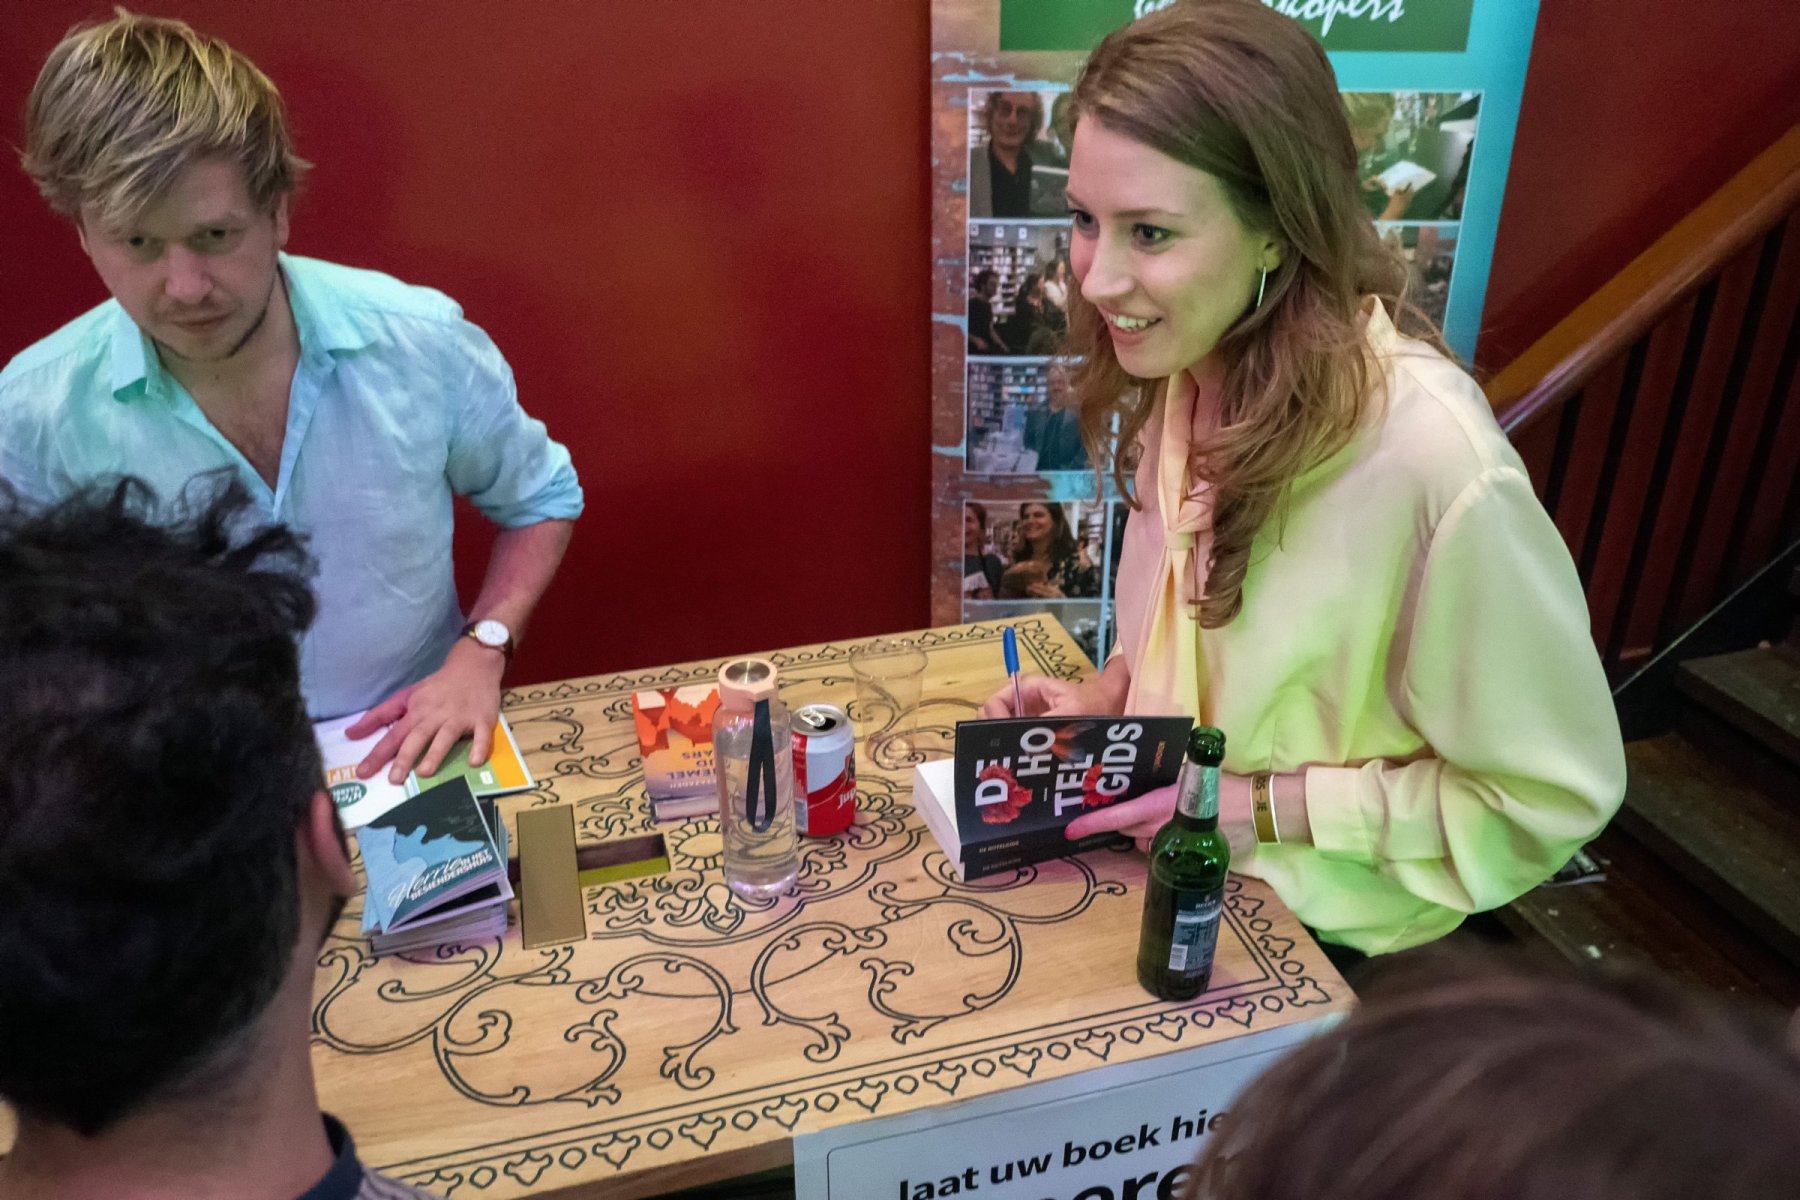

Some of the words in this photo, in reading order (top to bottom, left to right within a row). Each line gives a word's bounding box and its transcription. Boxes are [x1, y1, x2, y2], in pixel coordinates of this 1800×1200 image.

[1016, 726, 1056, 777] HO
[1095, 722, 1144, 796] GIDS
[837, 787, 857, 810] Jup
[1054, 753, 1094, 816] TEL
[899, 1165, 980, 1200] laat
[990, 1152, 1052, 1185] uw
[1062, 1123, 1162, 1168] boek
[1171, 1110, 1226, 1142] hie
